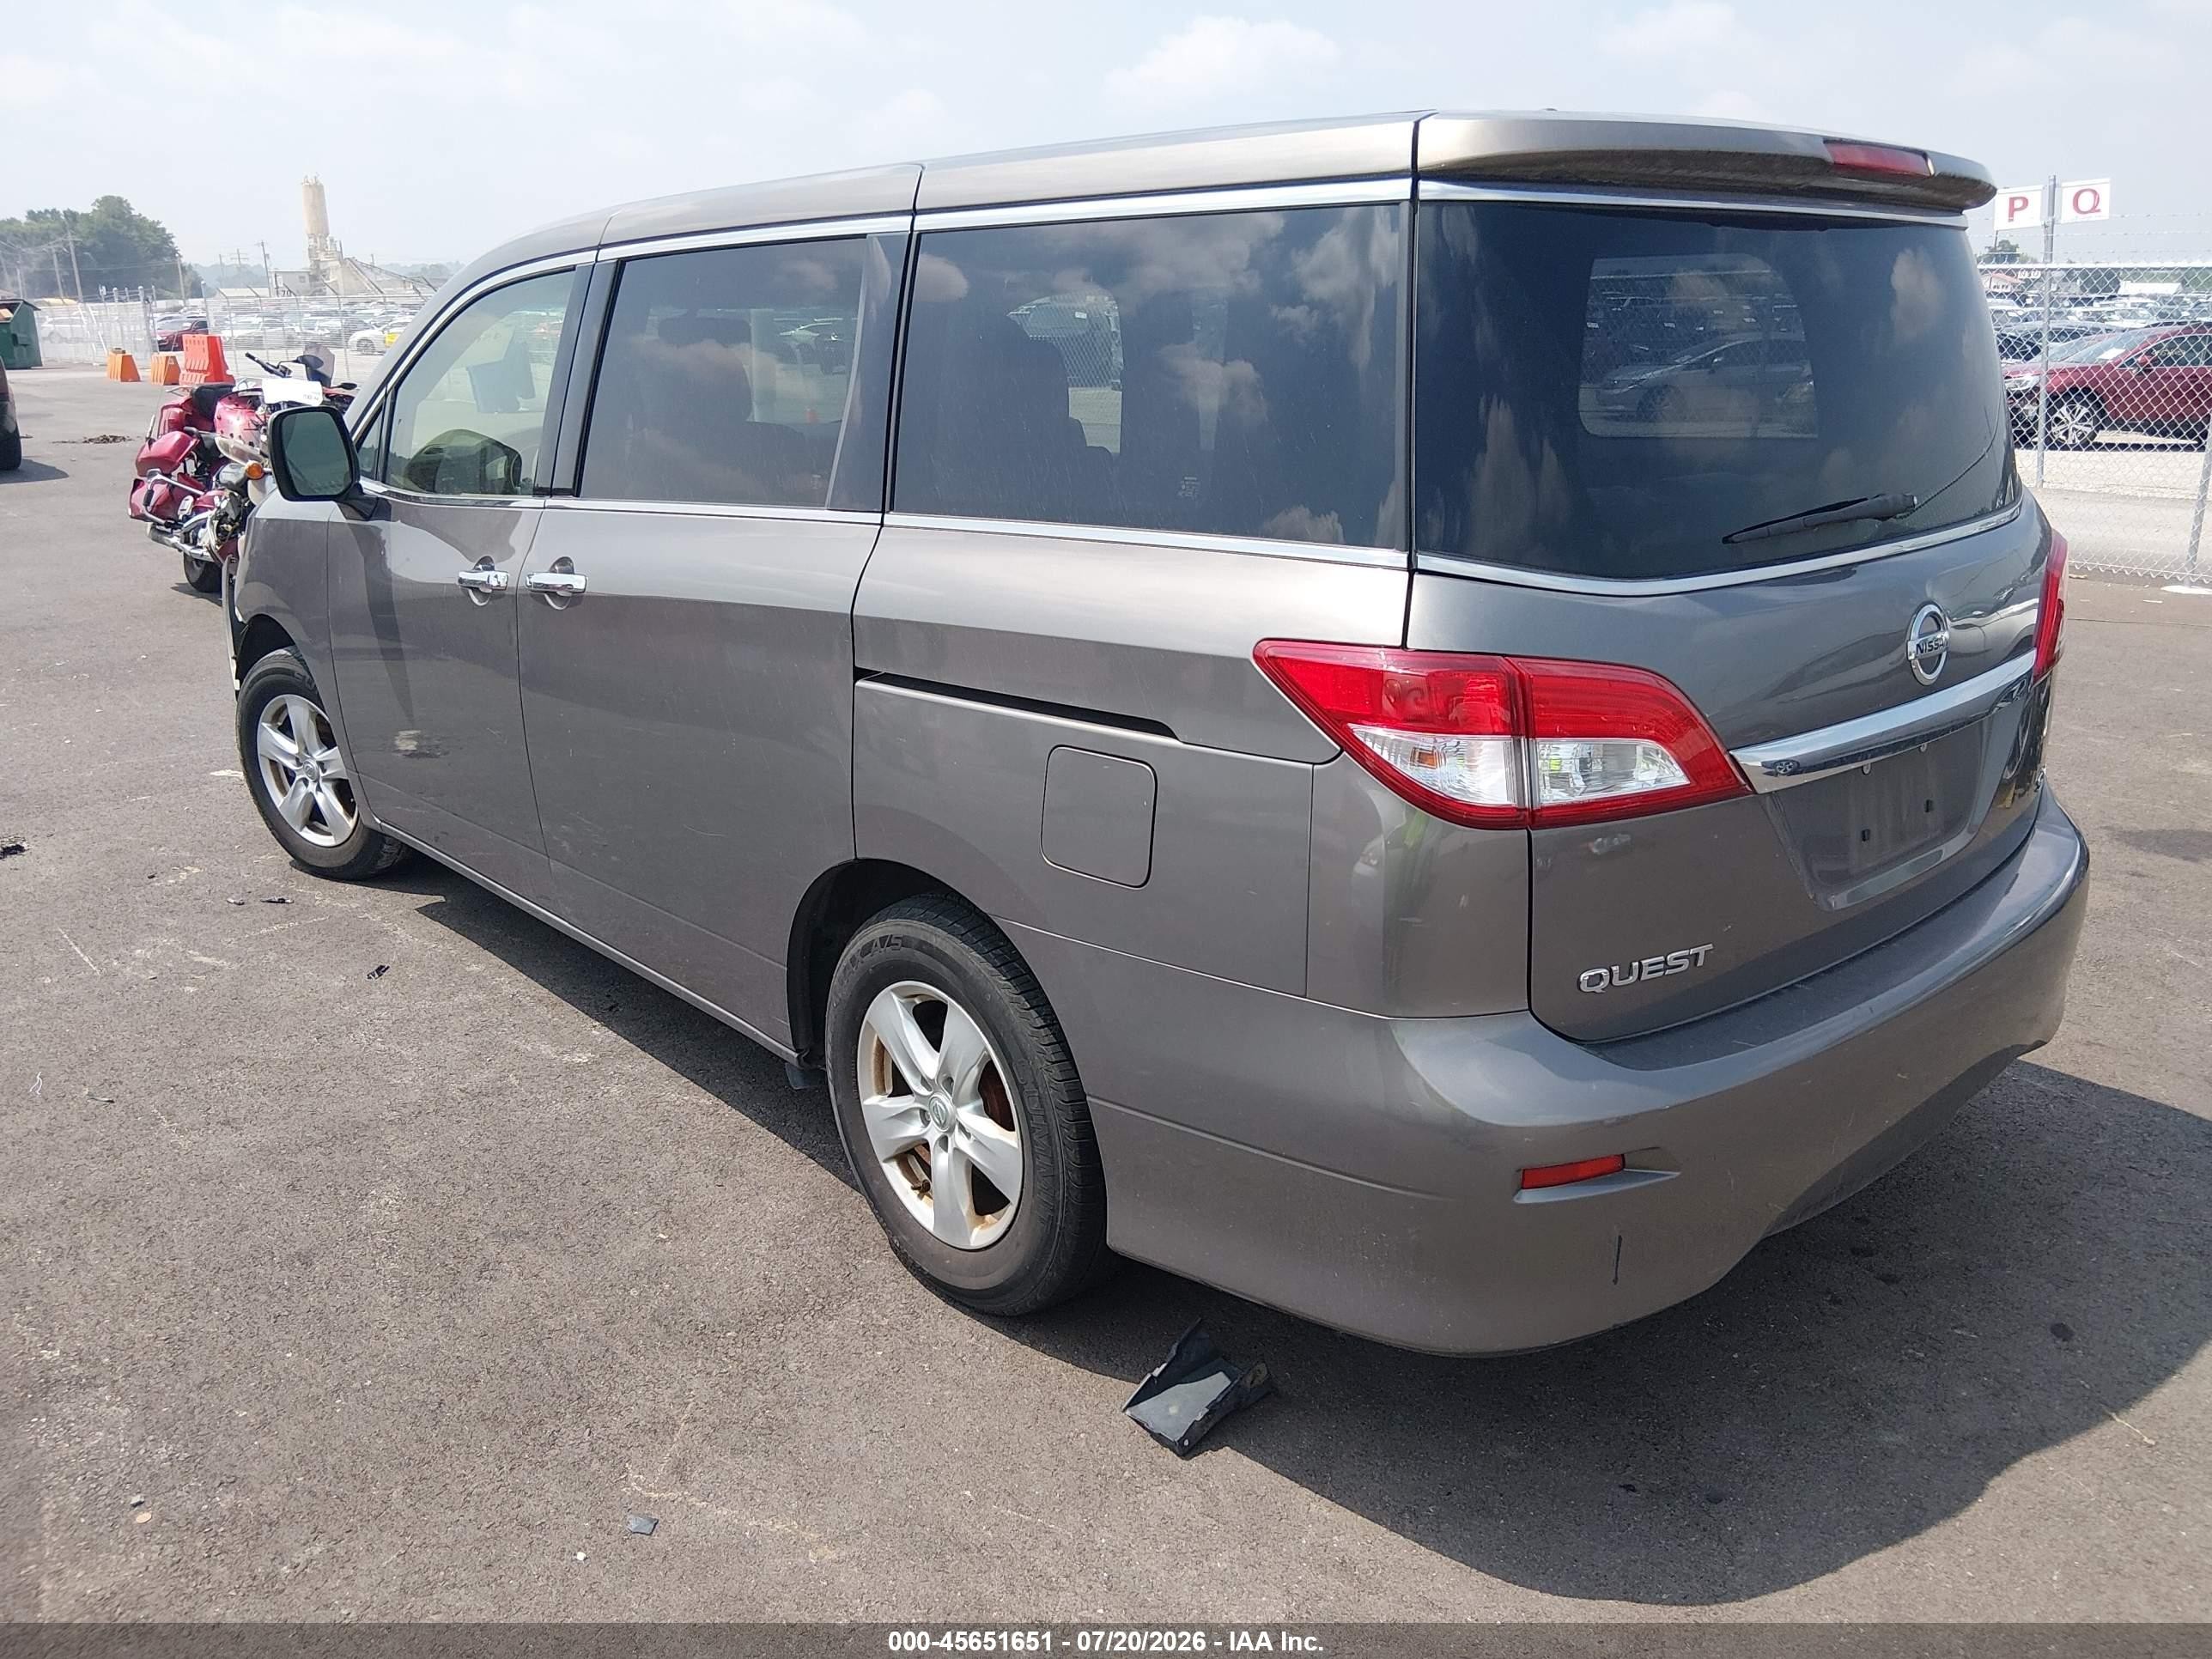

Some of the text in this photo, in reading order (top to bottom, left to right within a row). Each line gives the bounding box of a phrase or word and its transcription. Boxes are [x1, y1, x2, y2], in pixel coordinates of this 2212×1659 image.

[2008, 196, 2029, 222] P
[2072, 188, 2101, 215] Q
[1578, 943, 1714, 994] QUEST
